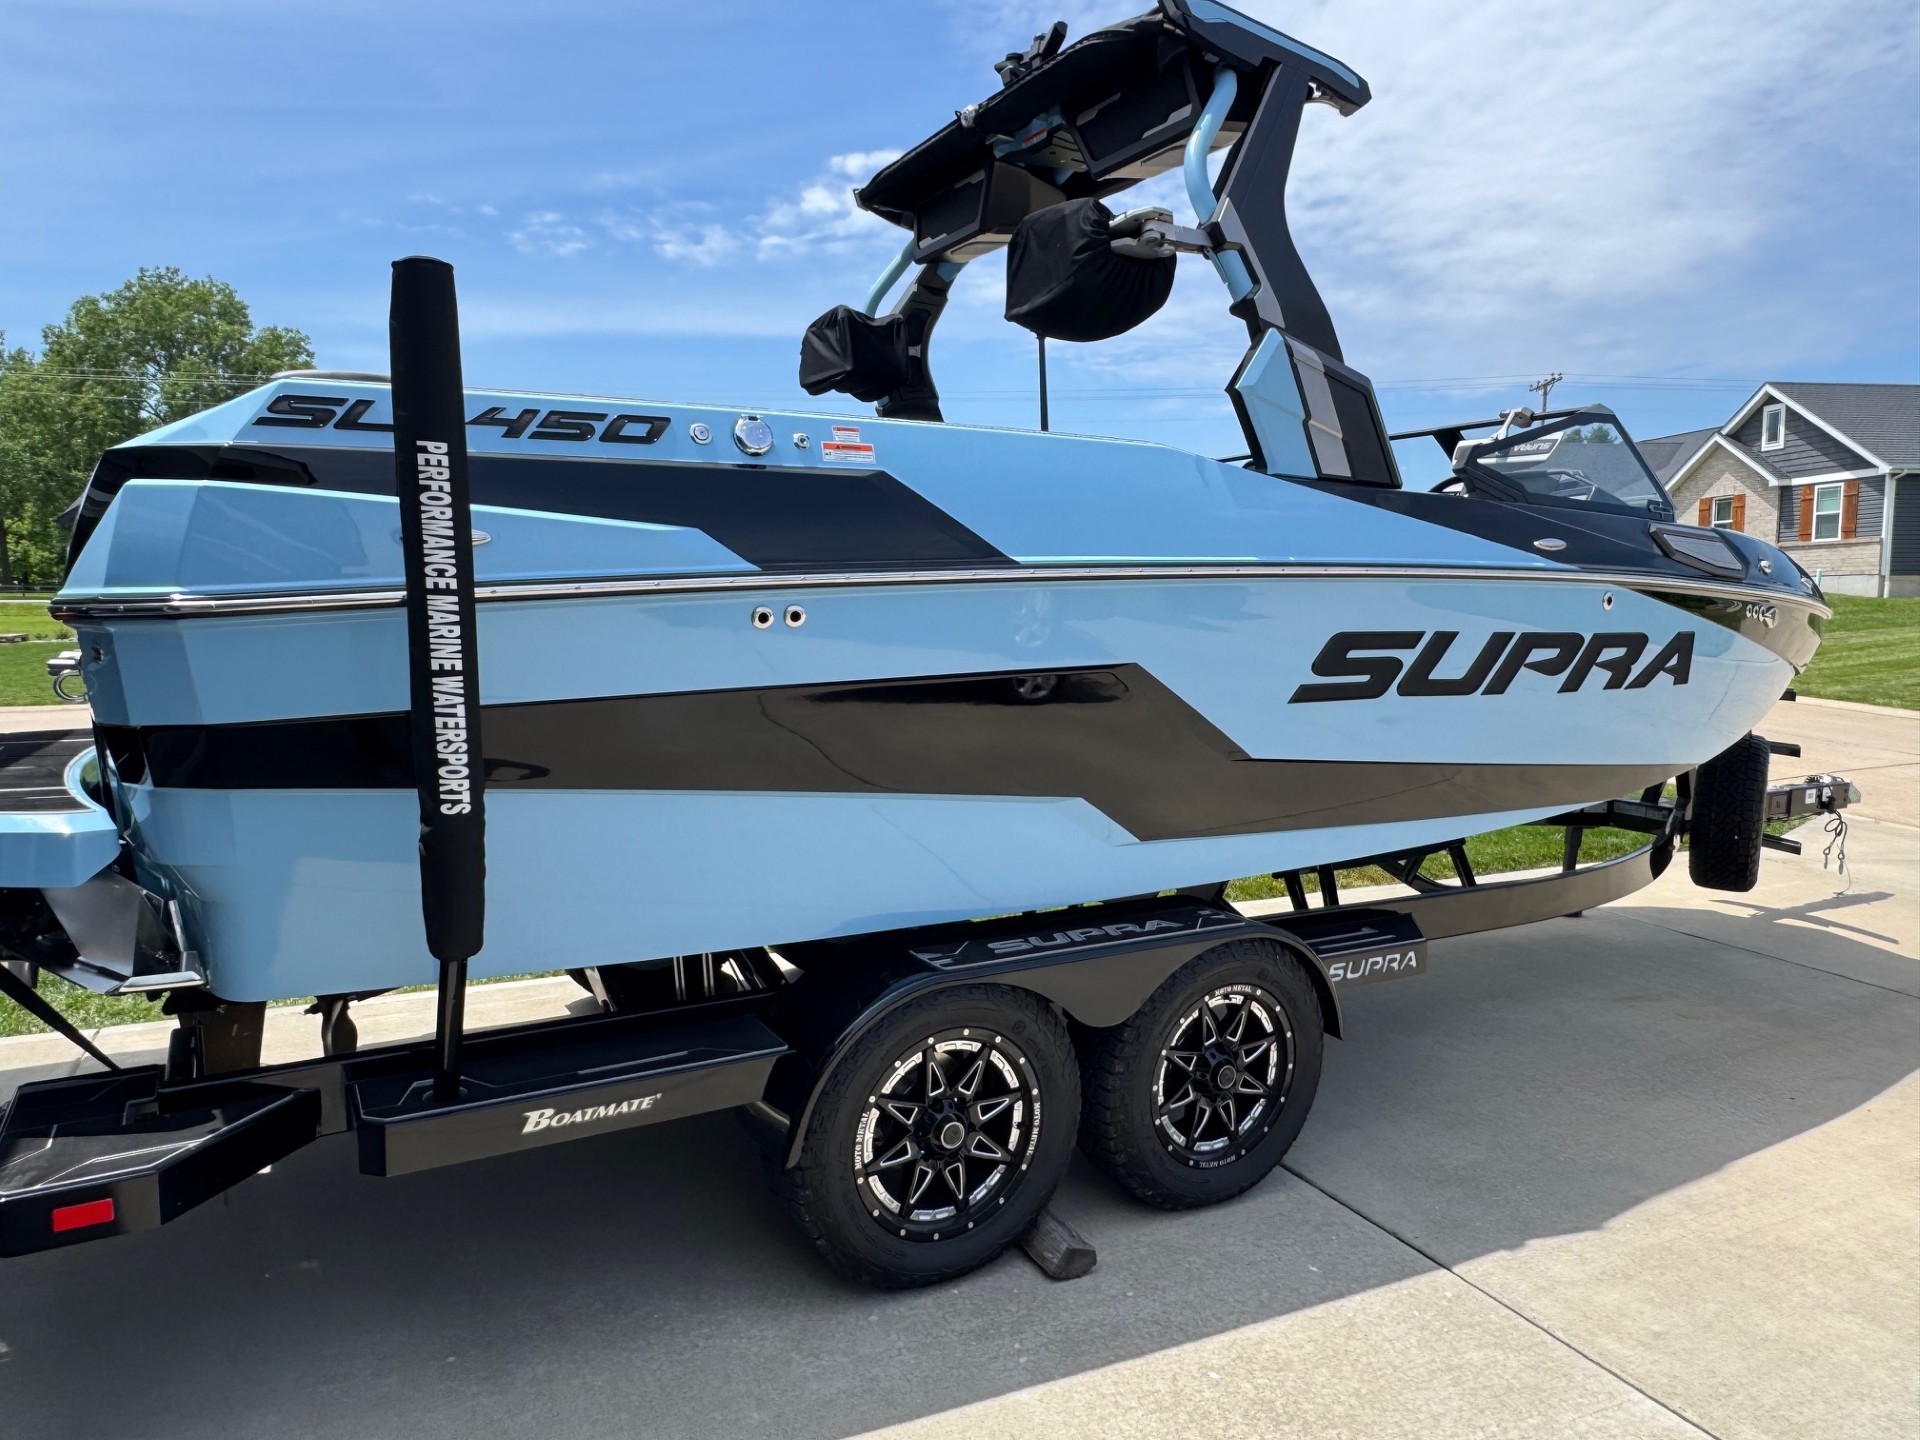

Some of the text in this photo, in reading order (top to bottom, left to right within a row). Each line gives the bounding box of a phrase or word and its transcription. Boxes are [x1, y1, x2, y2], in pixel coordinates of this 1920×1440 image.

[465, 405, 672, 444] 450
[416, 441, 471, 815] PERFORMANCE MARINE WATERSPORTS
[1287, 630, 1696, 704] SUPRA
[986, 918, 1185, 954] SUPRA
[1329, 951, 1418, 982] SUPRA
[854, 1111, 868, 1171] MOTO METAL
